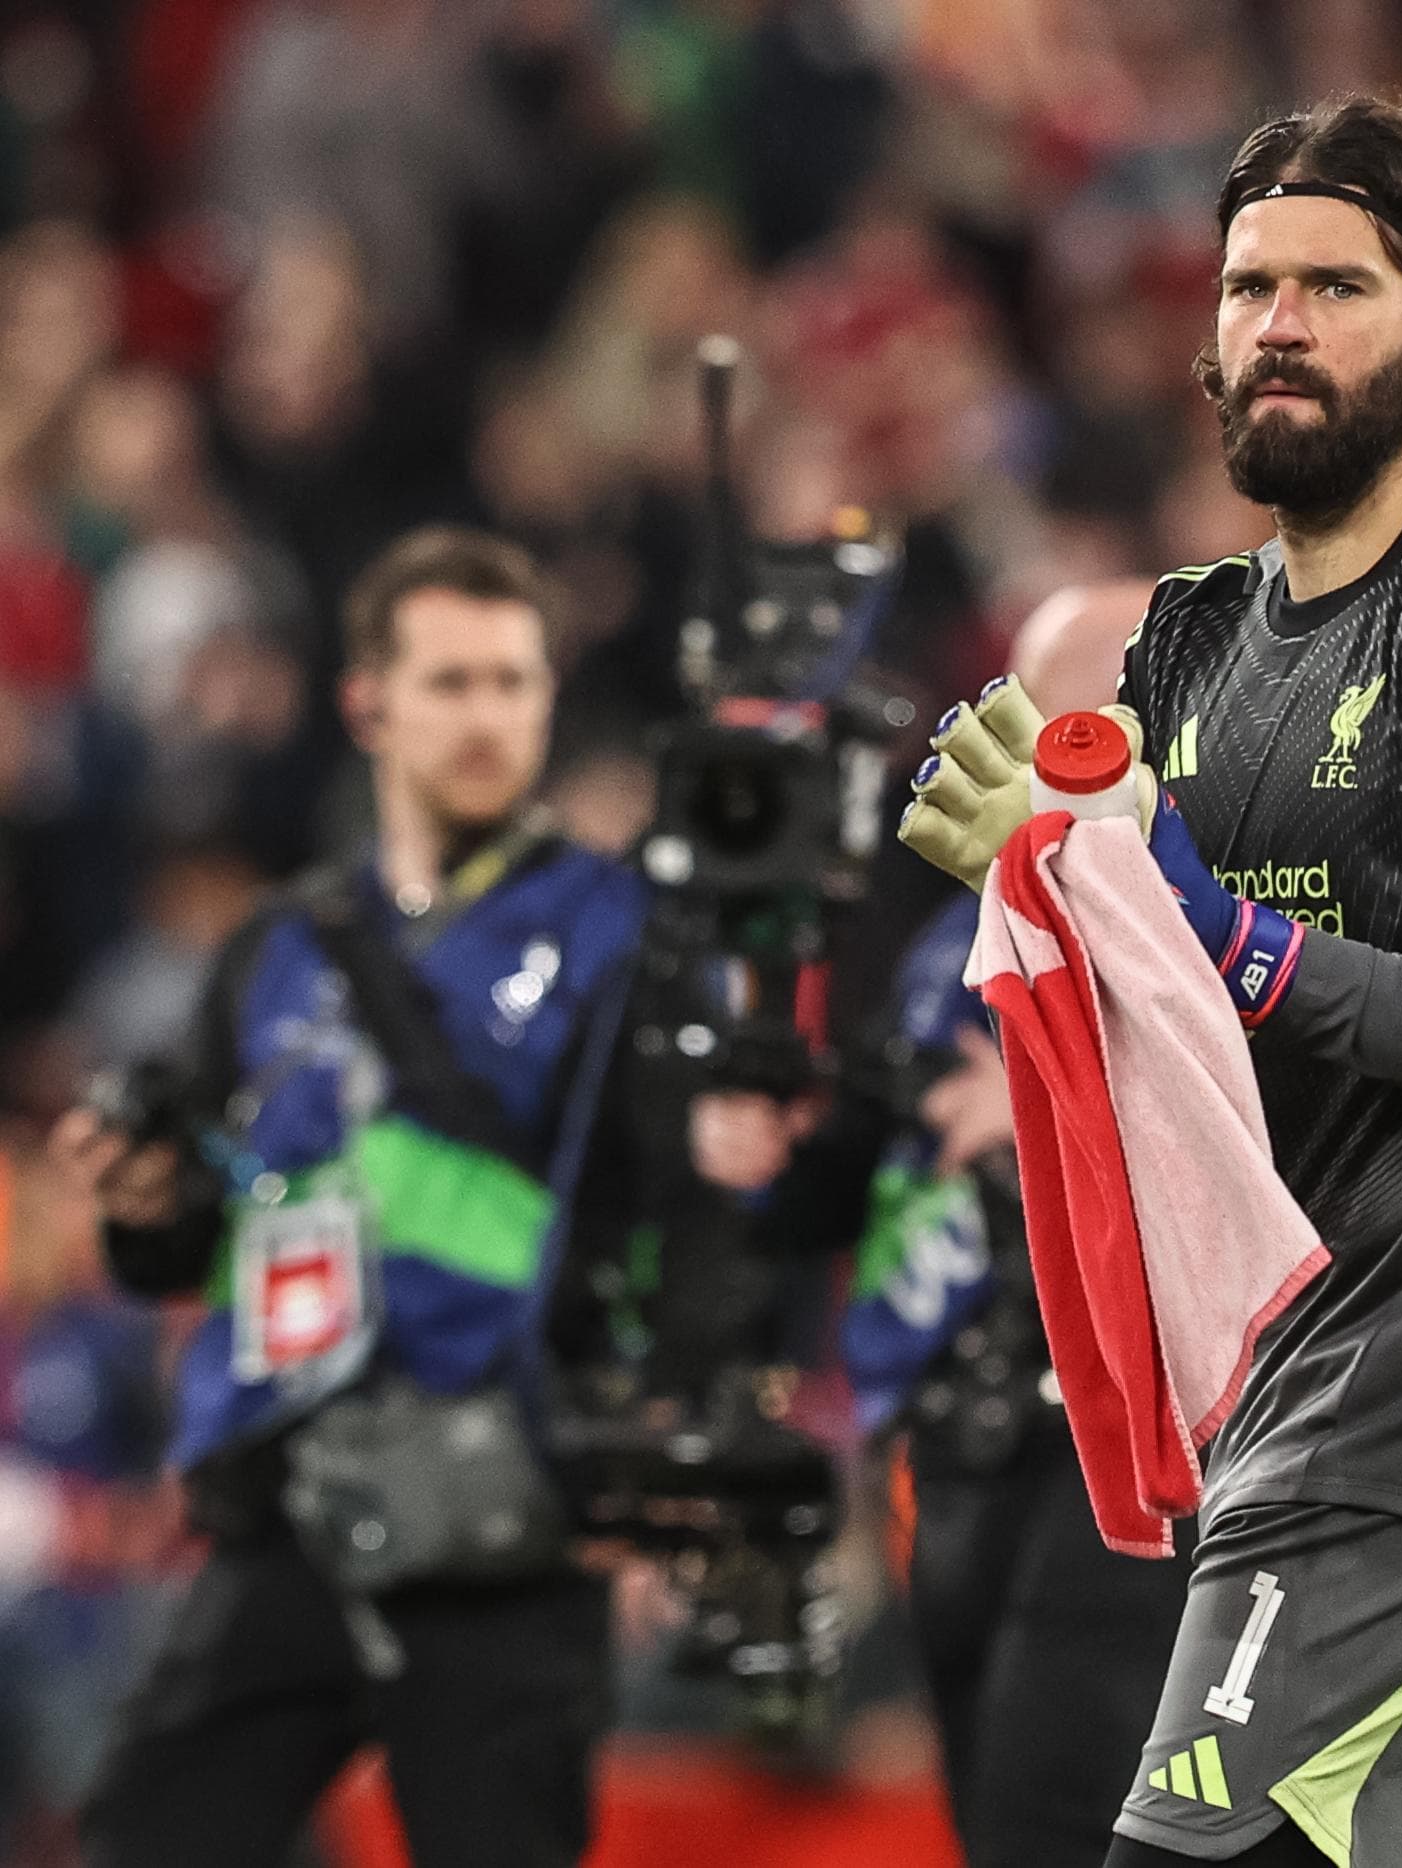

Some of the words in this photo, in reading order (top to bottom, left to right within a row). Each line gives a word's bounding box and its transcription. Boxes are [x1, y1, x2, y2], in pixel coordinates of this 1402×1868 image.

[1212, 859, 1330, 900] tandard
[1240, 949, 1275, 1001] AB1
[1203, 1570, 1286, 1726] 1
